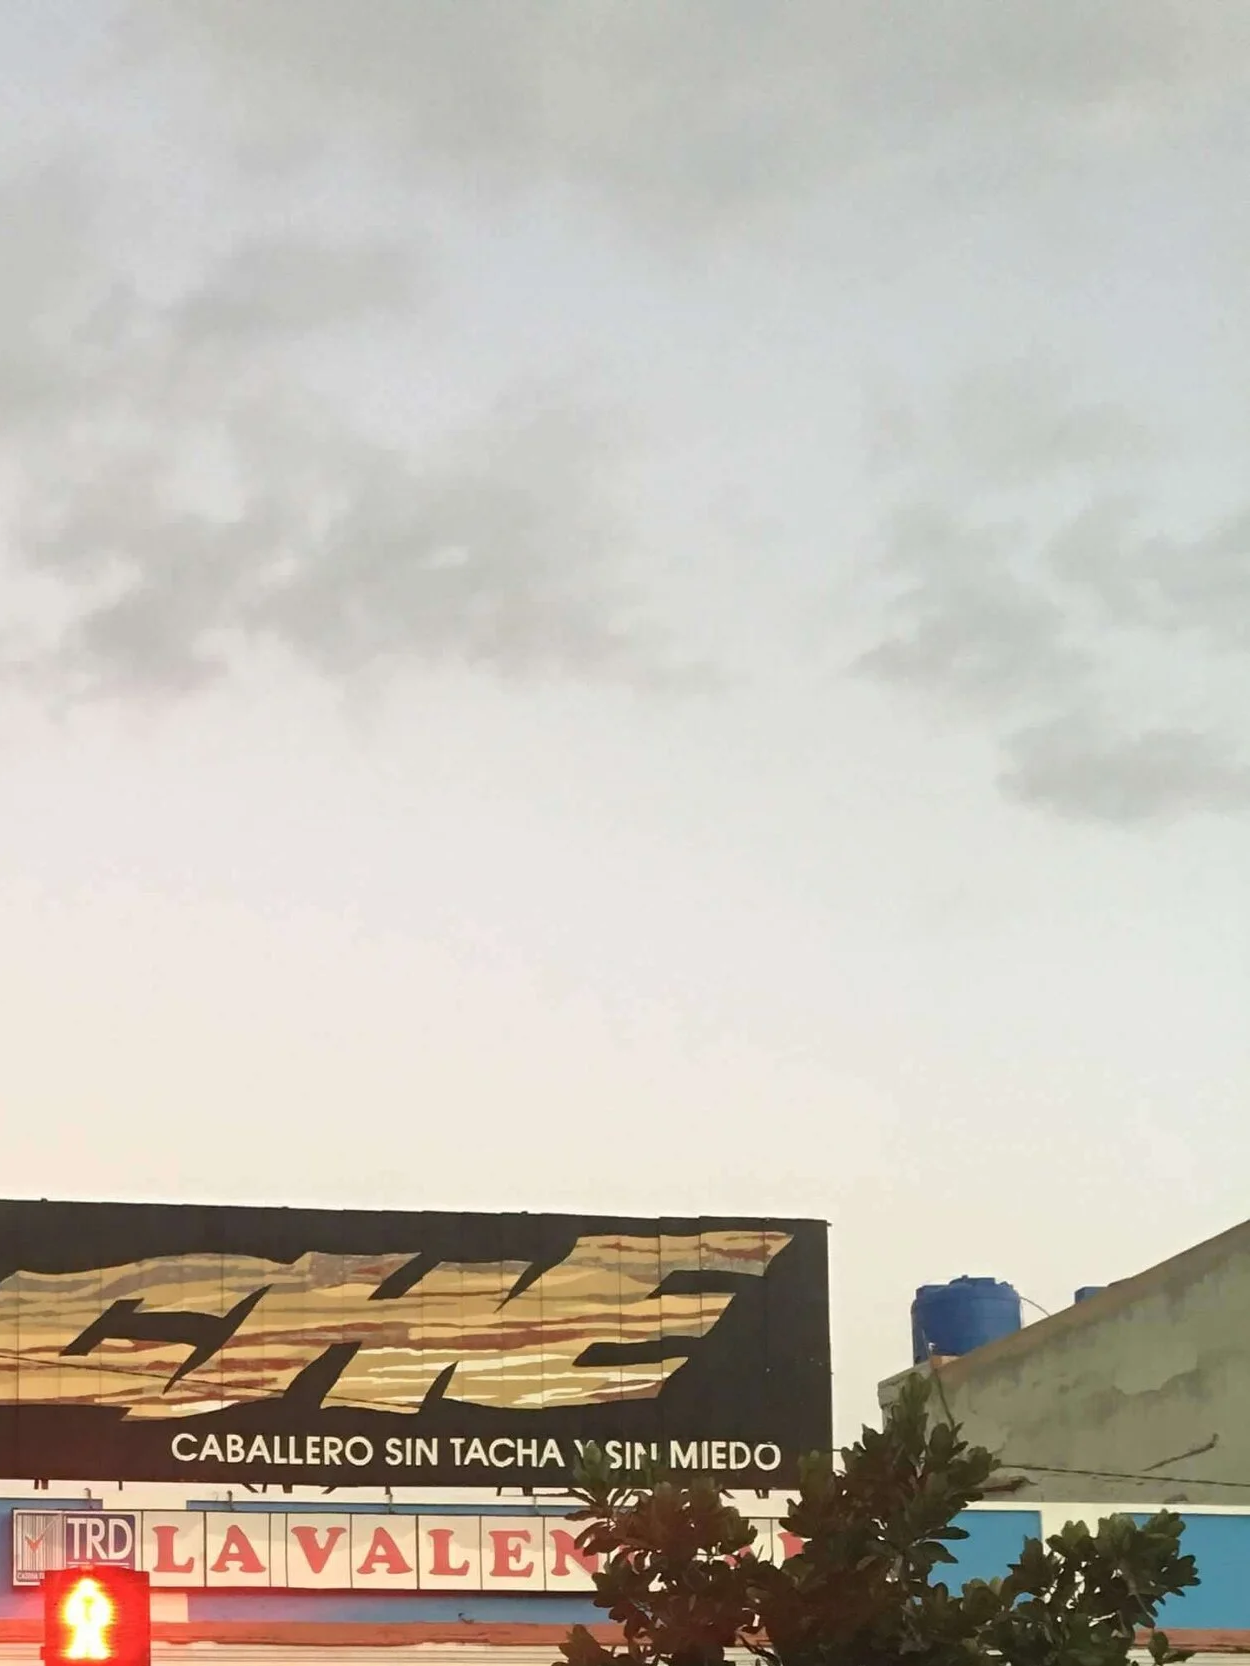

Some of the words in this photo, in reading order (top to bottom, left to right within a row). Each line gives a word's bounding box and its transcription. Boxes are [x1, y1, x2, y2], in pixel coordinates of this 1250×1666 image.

[171, 1433, 374, 1466] CABALLERO
[385, 1436, 438, 1467] SIN
[450, 1437, 565, 1468] TACHA
[605, 1440, 657, 1470] SIN
[670, 1440, 782, 1471] MIEDO
[67, 1517, 133, 1560] TRD
[152, 1524, 267, 1574] LA
